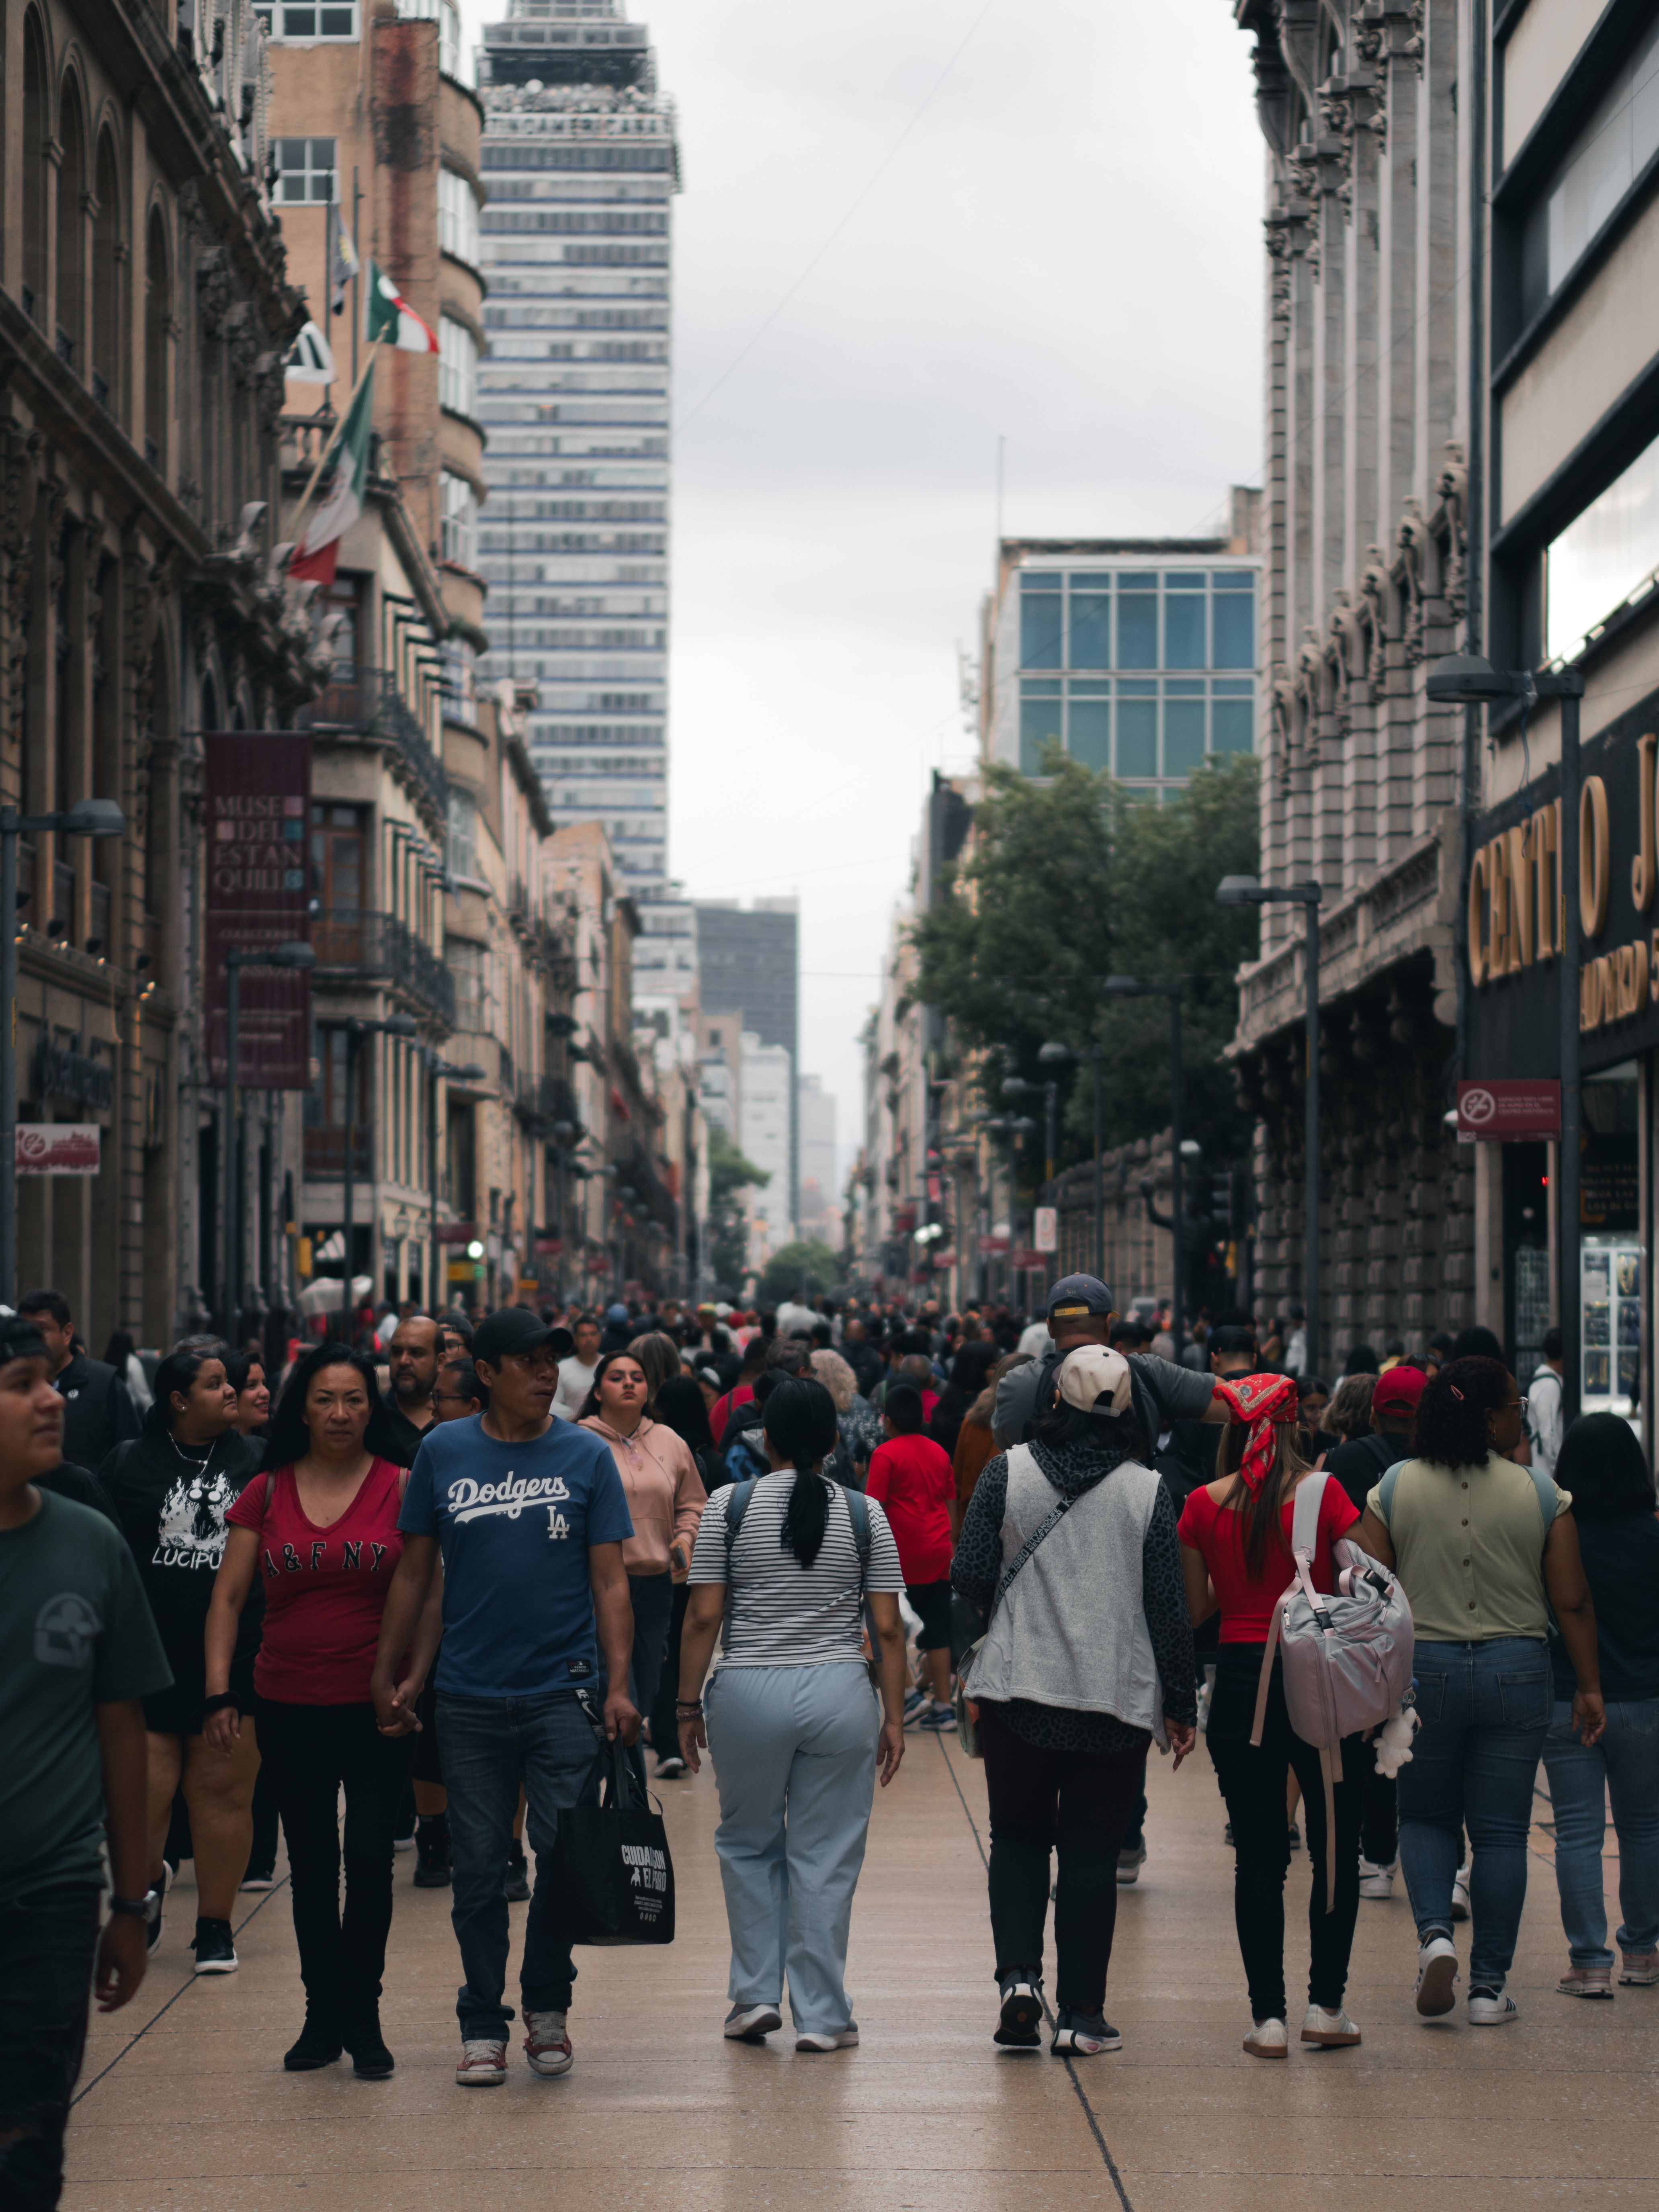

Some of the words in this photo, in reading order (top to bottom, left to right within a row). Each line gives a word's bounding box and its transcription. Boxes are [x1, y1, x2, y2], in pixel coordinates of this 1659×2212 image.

[1468, 775, 1610, 988] CENTO
[448, 1471, 567, 1519] Dodgers
[547, 1505, 570, 1539] LA
[1025, 1507, 1060, 1547] CITYANDLIFE
[1029, 1510, 1064, 1551] NEWFASHION
[152, 1547, 223, 1570] LUCIPU
[643, 1867, 651, 1888] EL
